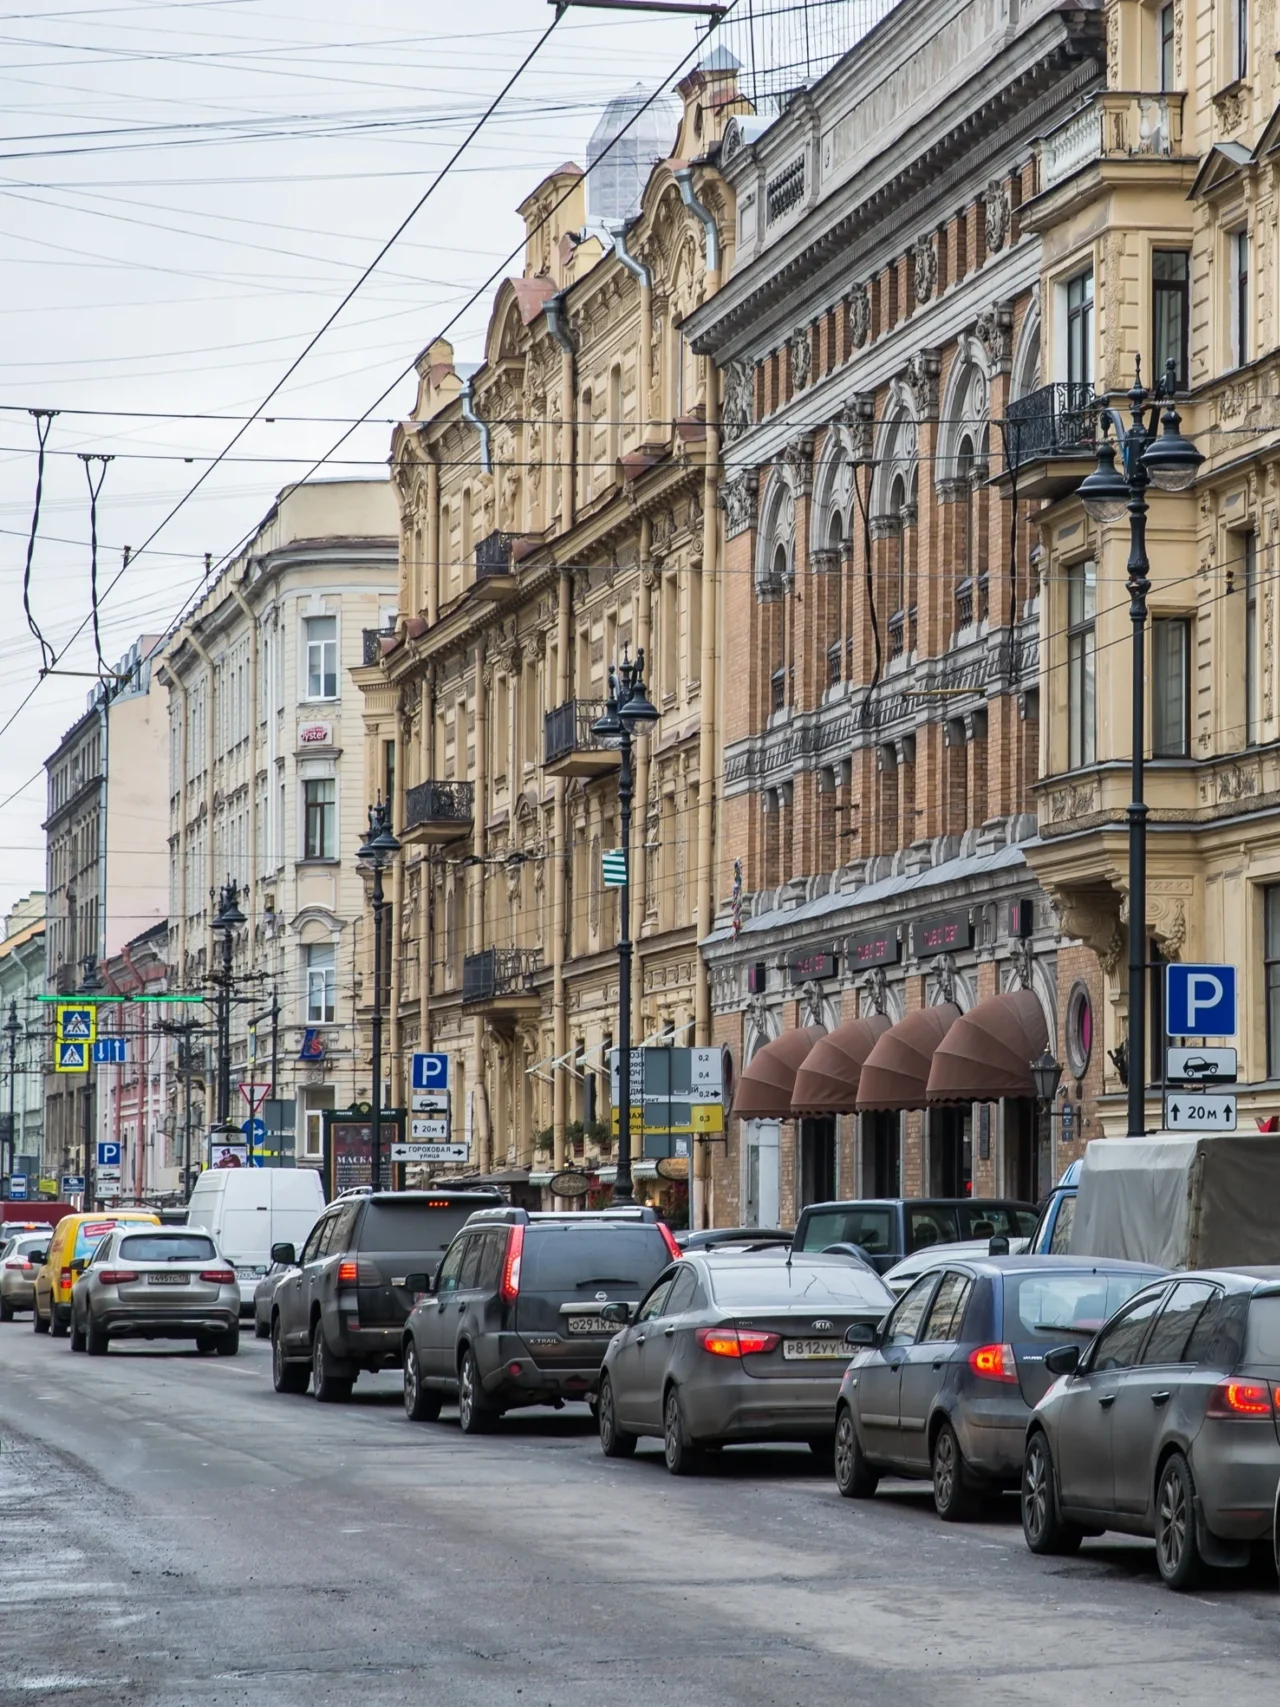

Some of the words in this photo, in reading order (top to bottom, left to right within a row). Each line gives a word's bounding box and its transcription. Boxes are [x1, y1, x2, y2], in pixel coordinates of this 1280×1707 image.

[698, 1054, 709, 1062] 0,2
[1187, 1107, 1218, 1121] 20м
[699, 1115, 711, 1123] 0,3
[422, 1125, 438, 1133] 20м
[408, 1145, 451, 1153] ГОРОХОВАЯ
[787, 1341, 837, 1354] Р812УУ
